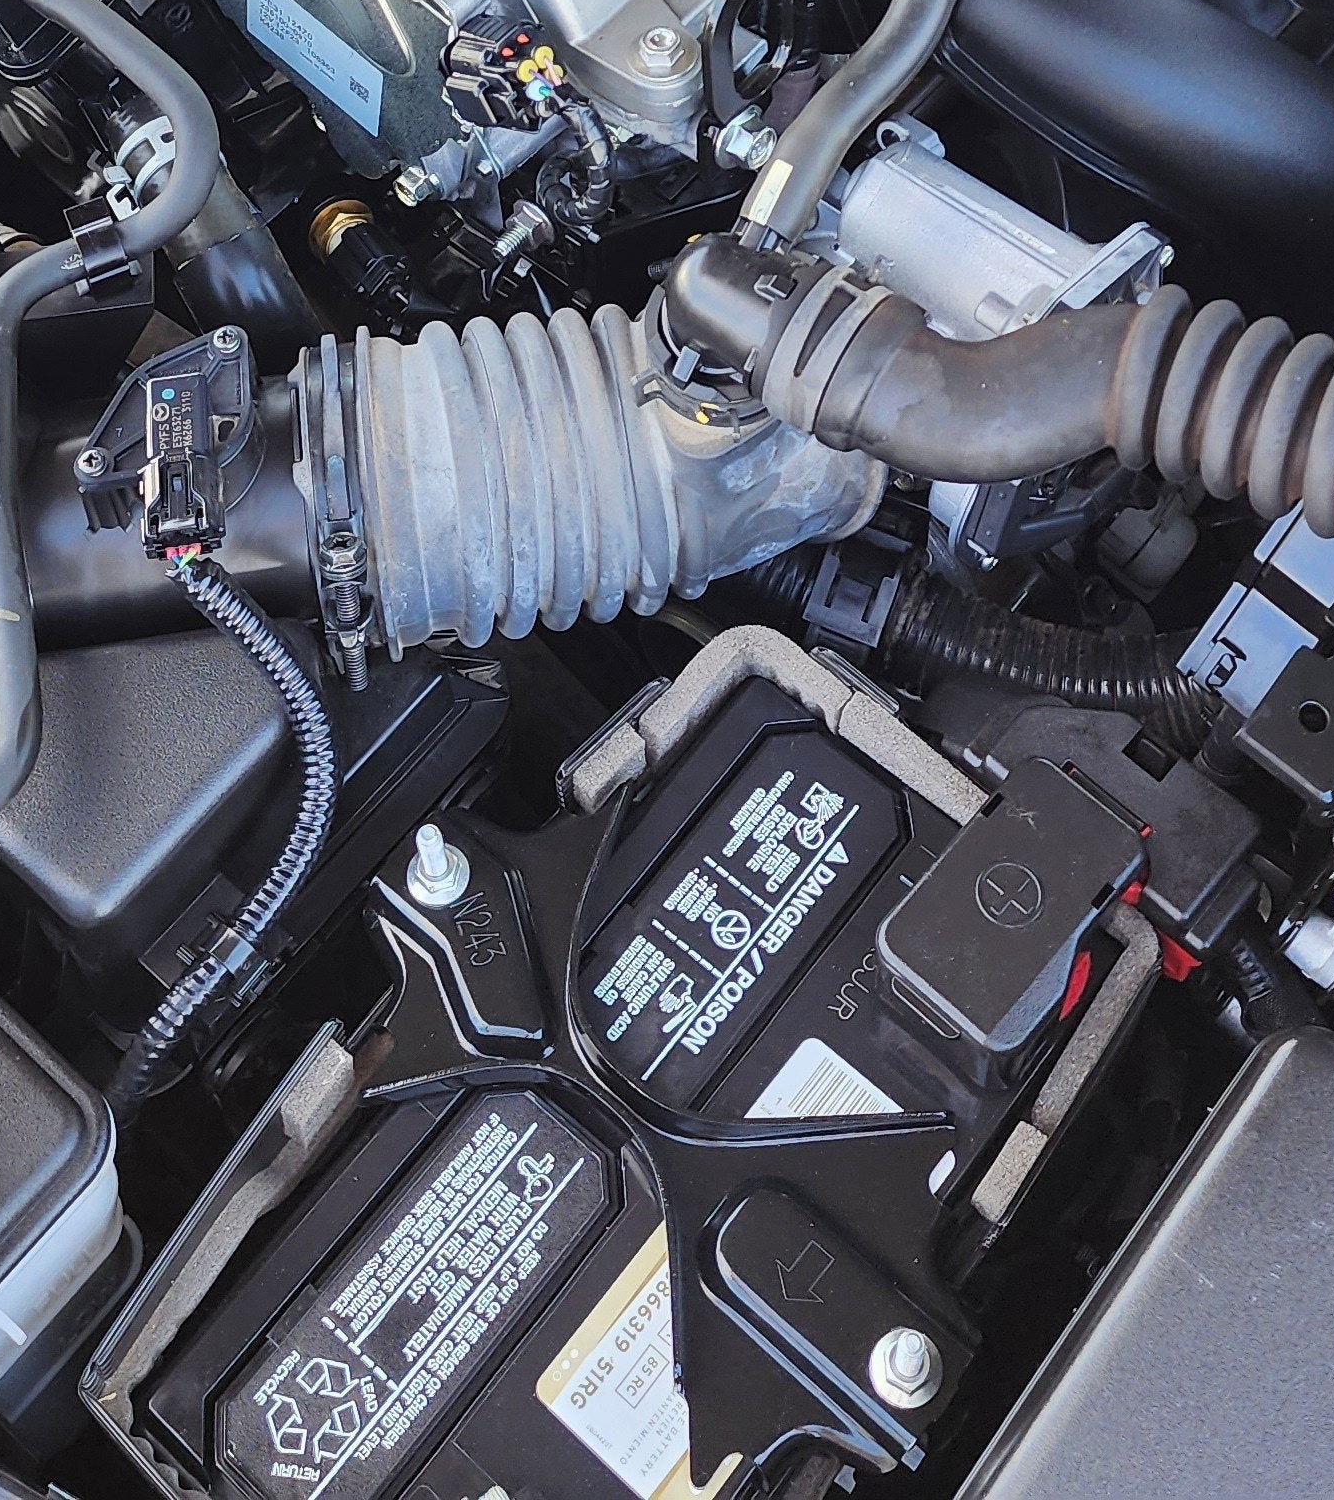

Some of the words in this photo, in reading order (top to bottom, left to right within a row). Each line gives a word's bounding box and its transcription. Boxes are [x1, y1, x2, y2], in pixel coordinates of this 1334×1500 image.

[159, 422, 169, 449] PYFS
[172, 405, 181, 449] E5T63271
[744, 808, 798, 874] EXPLOSIVE
[750, 801, 787, 844] GASES
[759, 841, 791, 877] EYES
[762, 850, 802, 895] SHIELD
[700, 899, 723, 924] NO
[755, 863, 837, 955] DANGER
[449, 889, 507, 969] N243
[612, 939, 656, 992] BLINDNESS
[614, 932, 647, 971] SEVERE
[643, 948, 665, 972] CAN
[591, 964, 622, 1000] BURNS
[600, 987, 619, 1007] OR
[618, 967, 650, 1004] CAUSE
[624, 955, 676, 1016] SULFURIC
[602, 1009, 634, 1044] ACID
[677, 964, 756, 1056] POISON
[468, 1120, 493, 1147] NOT
[486, 1111, 500, 1125] IF
[429, 1140, 476, 1195] AVAILABLE
[448, 1119, 511, 1192] INSTRUCTIONS
[409, 1187, 437, 1218] SEEK
[439, 1185, 457, 1203] IN
[461, 1170, 486, 1196] FOR
[407, 1195, 447, 1243] VEHICLE
[440, 1190, 469, 1222] SAFE
[458, 1177, 509, 1238] MEDICAL
[485, 1188, 521, 1230] WITH
[490, 1198, 534, 1248] FLUSH
[377, 1211, 416, 1257] SERVICE
[419, 1214, 449, 1248] JUMP
[511, 1236, 537, 1264] NOT
[528, 1219, 550, 1242] DO
[374, 1234, 415, 1282] OWNERS
[381, 1240, 428, 1296] STARTING
[430, 1230, 467, 1272] HELP
[465, 1239, 501, 1280] EYES
[514, 1249, 542, 1281] KEEP
[402, 1264, 440, 1306] FAST
[426, 1267, 458, 1303] GET
[470, 1281, 501, 1316] KEEP
[495, 1276, 521, 1305] OUT
[346, 1287, 388, 1335] FOLLOW
[398, 1272, 475, 1363] IMMEDIATELY
[448, 1309, 479, 1344] VENT
[463, 1316, 489, 1345] THE
[480, 1300, 502, 1323] OF
[610, 1269, 678, 1355] 866319
[421, 1336, 456, 1377] CAPS
[435, 1338, 472, 1381] REACH
[638, 1354, 660, 1377] 85
[251, 1347, 301, 1406] RECYCLE
[359, 1376, 377, 1412] LEAD
[397, 1371, 427, 1406] TIGHT
[421, 1375, 441, 1397] OF
[566, 1353, 615, 1412] 51RG
[622, 1373, 646, 1398] RC
[378, 1401, 404, 1430] AND
[379, 1391, 428, 1451] CHILDREN
[351, 1424, 385, 1463] LEVEL
[637, 1424, 678, 1478] BATTERY
[271, 1462, 318, 1482] RETURN
